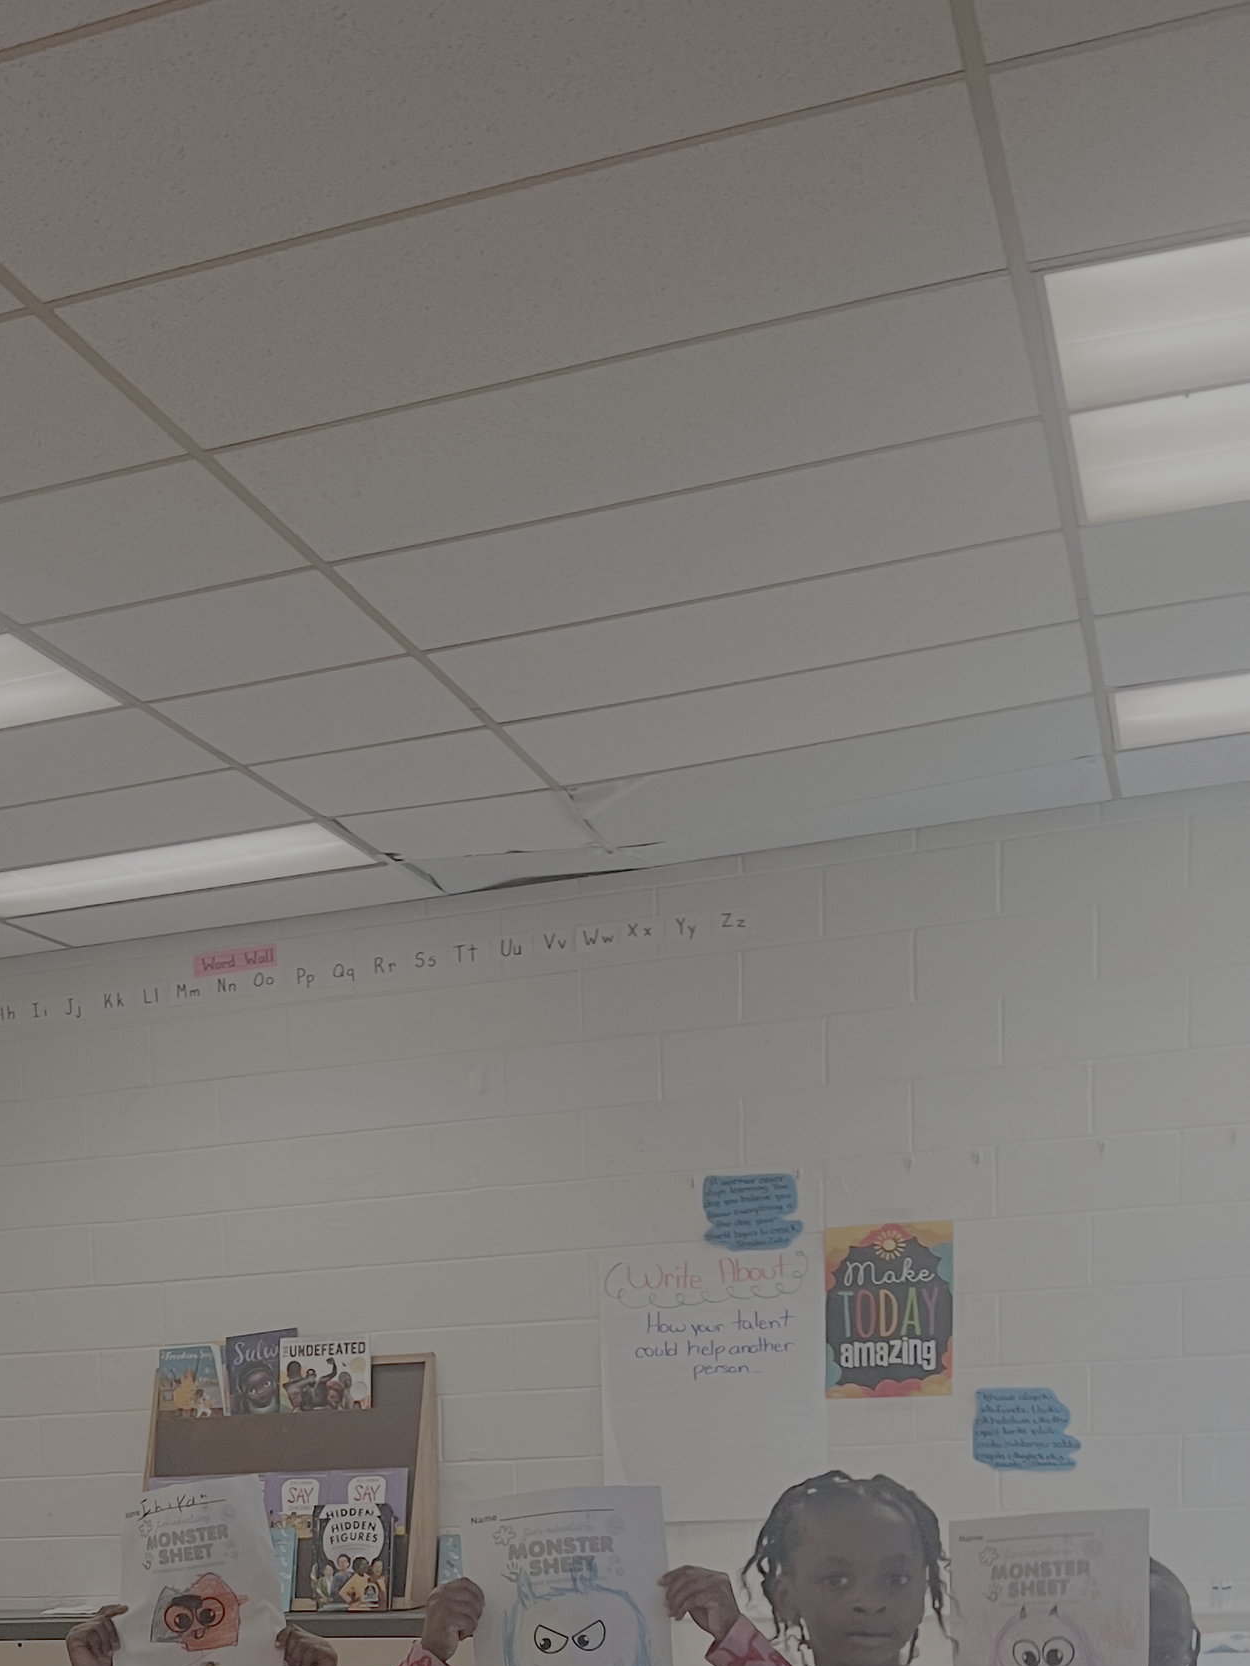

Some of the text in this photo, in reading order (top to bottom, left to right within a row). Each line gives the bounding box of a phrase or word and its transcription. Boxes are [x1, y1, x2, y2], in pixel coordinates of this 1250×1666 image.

[32, 1003, 47, 1018] Ii
[65, 998, 81, 1018] Jj
[104, 993, 124, 1008] Kk
[143, 988, 159, 1004] Ll
[177, 984, 200, 998] Mm
[217, 978, 236, 993] Nn
[254, 972, 274, 987] Oo
[297, 968, 314, 988] Pp
[333, 964, 355, 982] Qq
[374, 957, 396, 973] Rr
[415, 952, 436, 968] Ss
[453, 944, 478, 962] Tt
[501, 939, 522, 956] Uu
[544, 933, 566, 949] Vv
[583, 929, 614, 945] Ww
[628, 923, 652, 937] Xx
[676, 918, 696, 939] Yy
[721, 913, 745, 928] Zz
[201, 948, 274, 971] Word Wall
[627, 1253, 789, 1290] Write About
[843, 1257, 936, 1287] Make
[647, 1309, 796, 1338] How your talent
[837, 1286, 939, 1339] TODAY
[234, 1340, 279, 1366] Sulw
[289, 1341, 366, 1358] UNDEFEATED
[635, 1337, 795, 1362] could help another
[840, 1337, 937, 1371] amazing
[288, 1487, 315, 1504] SAY
[354, 1485, 381, 1502] SAY
[326, 1508, 375, 1518] HIDDEN
[471, 1515, 498, 1525] Name
[147, 1524, 229, 1551] MONSTER
[331, 1521, 377, 1534] HIDDEN
[330, 1533, 378, 1545] FIGURES
[508, 1536, 614, 1562] MONSTER
[159, 1543, 214, 1565] SHEET
[529, 1555, 596, 1577] SHEET
[991, 1560, 1090, 1580] MONSTER
[1008, 1579, 1070, 1598] SHEET
